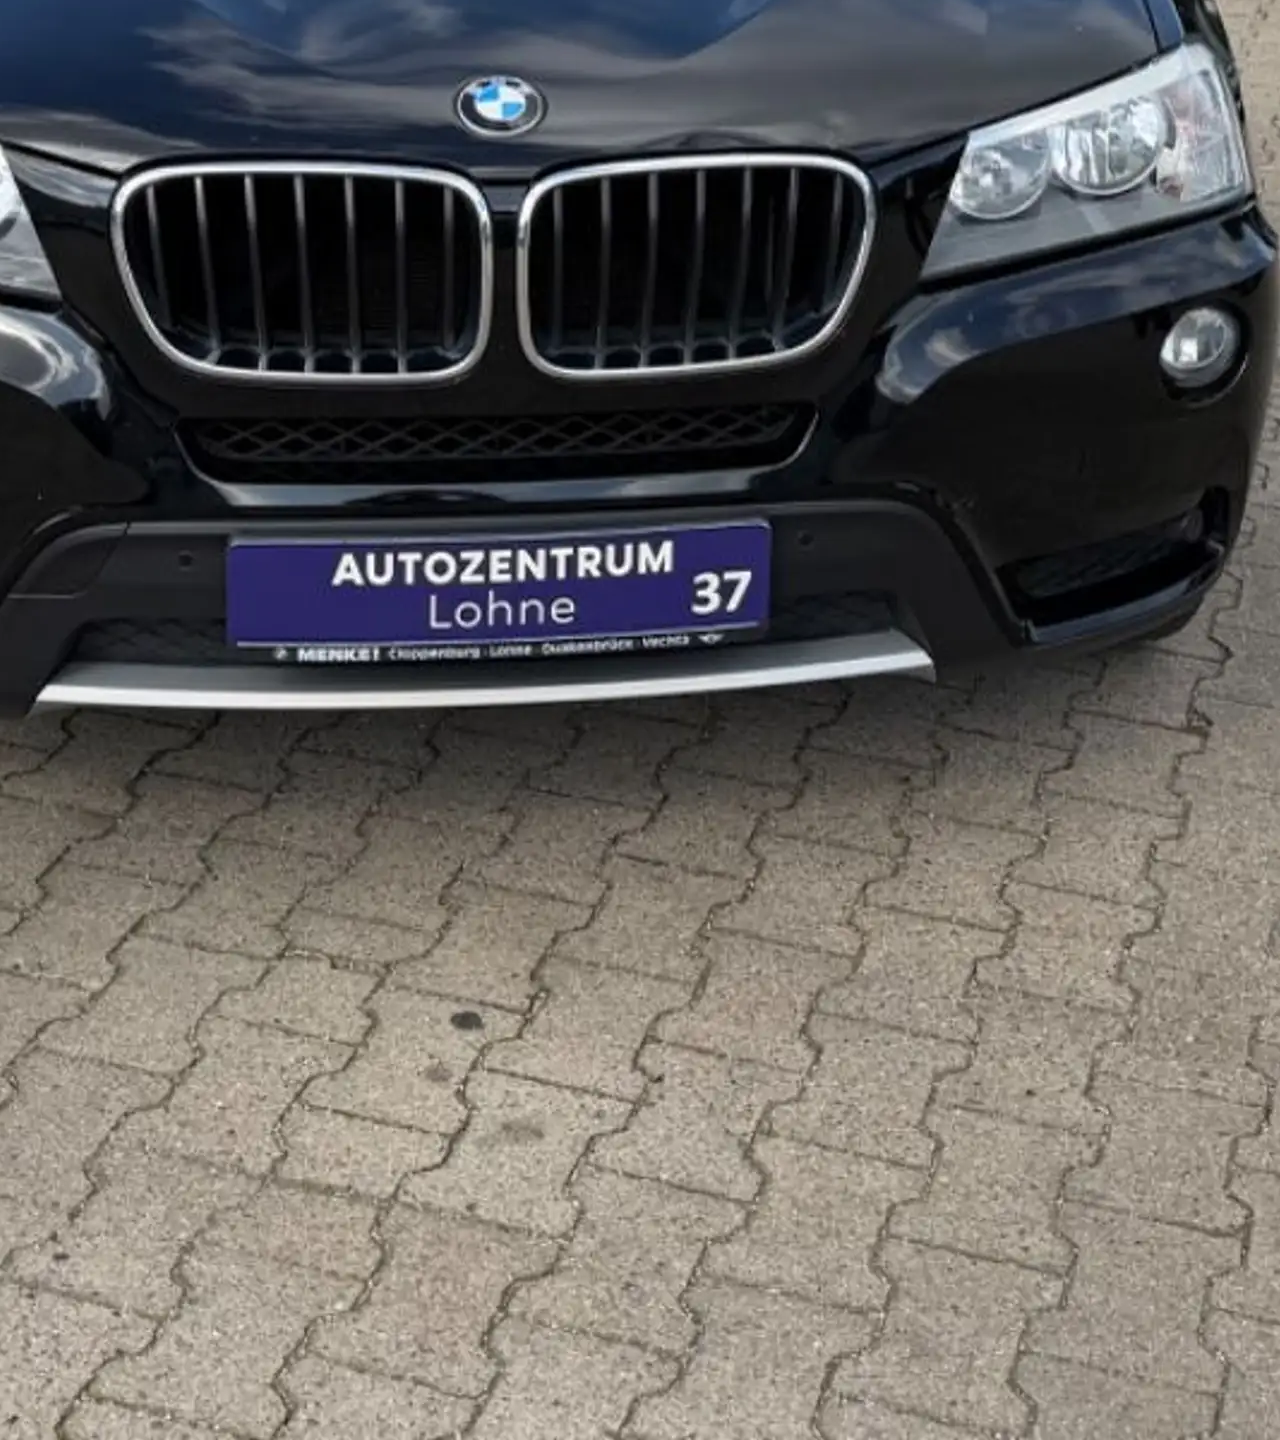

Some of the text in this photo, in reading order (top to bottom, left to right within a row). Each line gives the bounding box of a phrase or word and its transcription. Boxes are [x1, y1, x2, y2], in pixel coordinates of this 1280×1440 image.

[331, 540, 675, 587] AUTOZENTRUM
[429, 590, 577, 629] Lohne
[691, 571, 752, 615] 37
